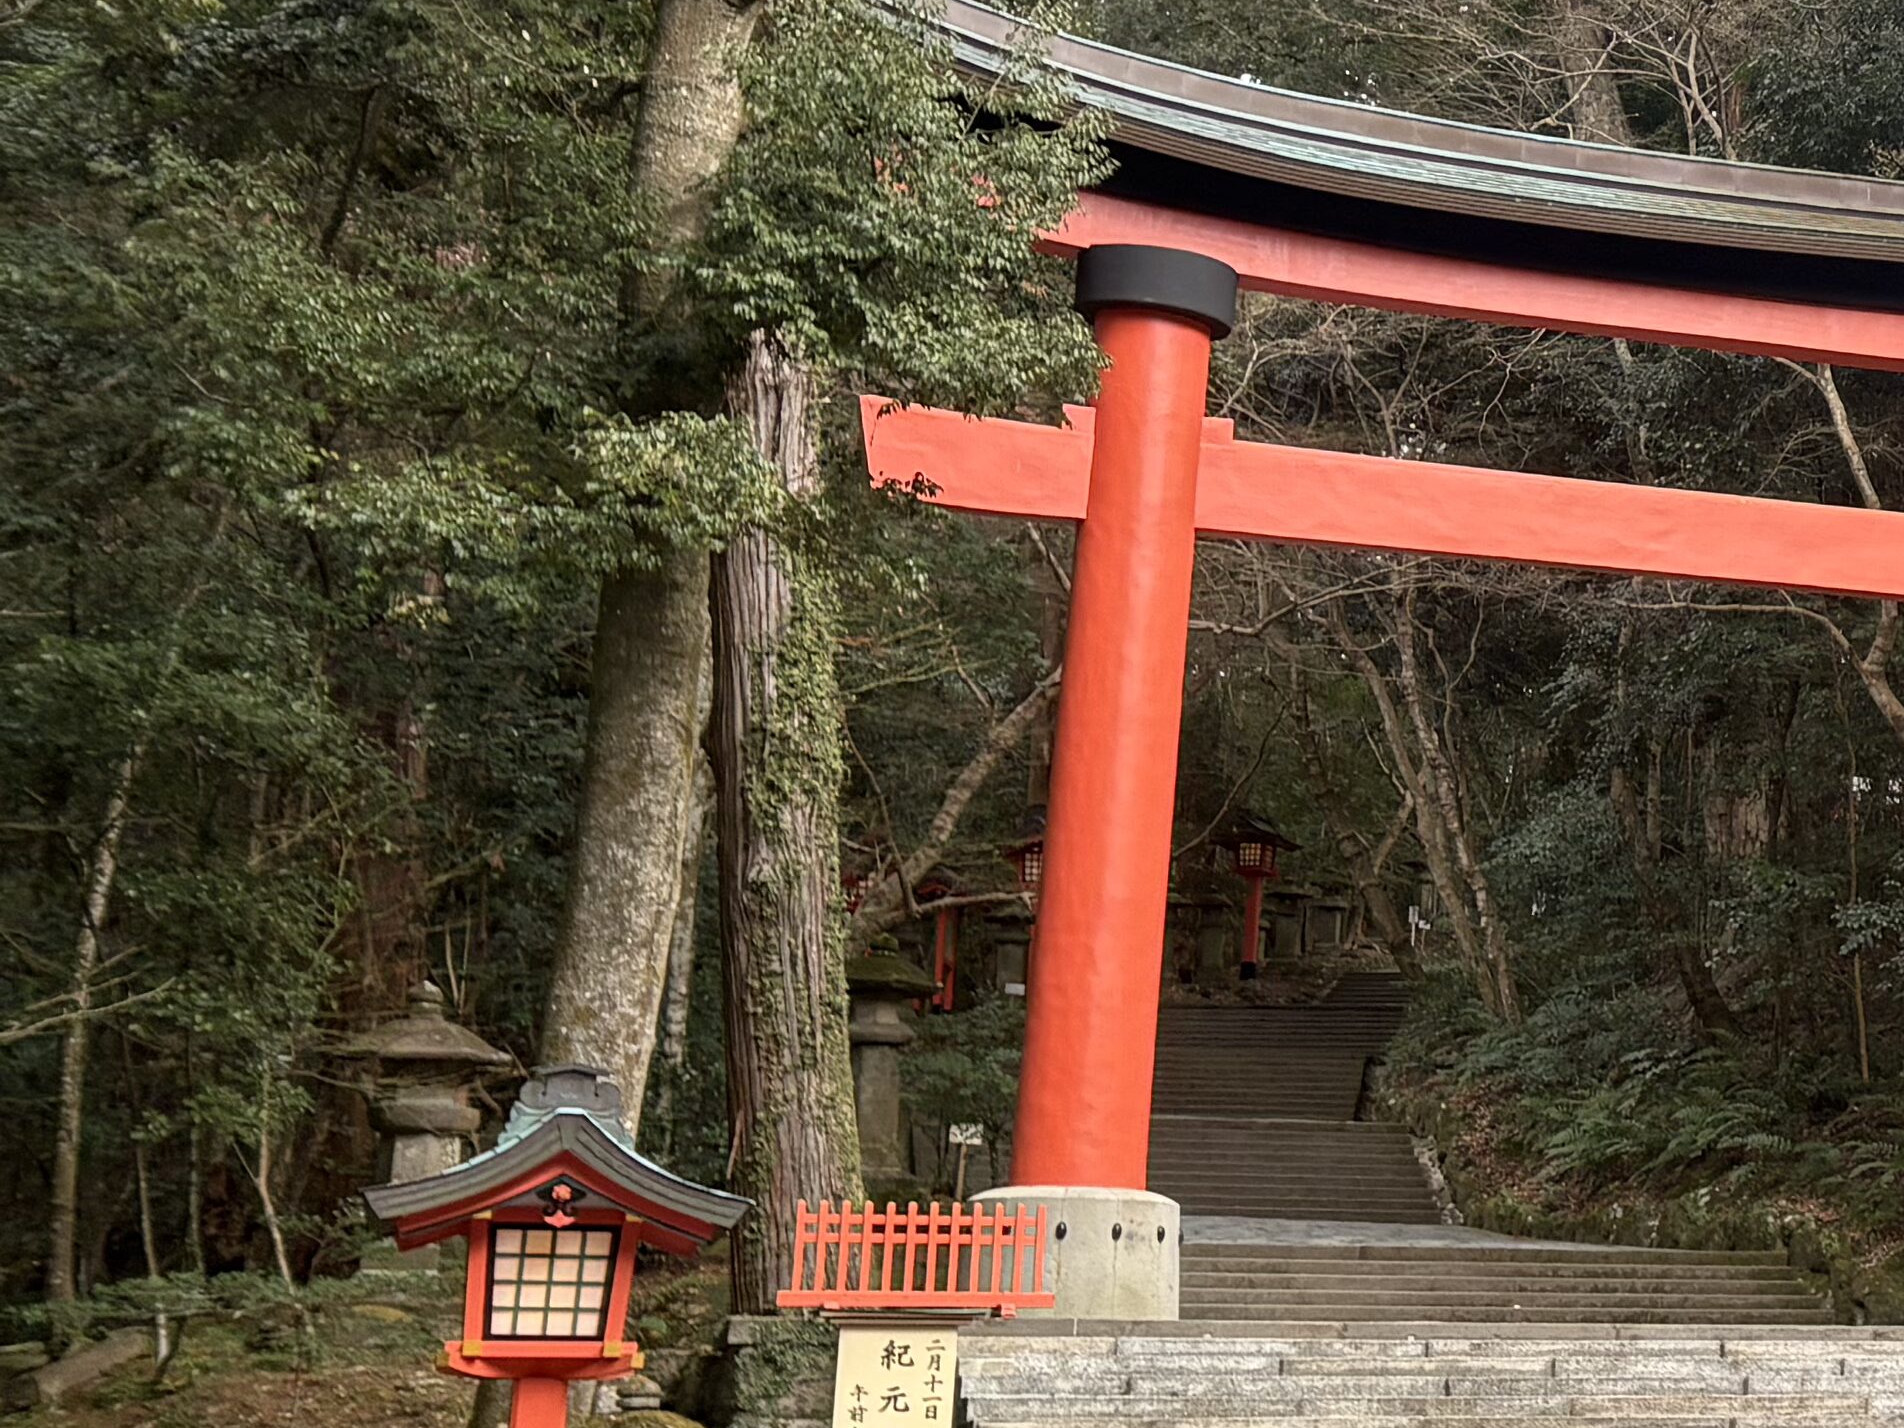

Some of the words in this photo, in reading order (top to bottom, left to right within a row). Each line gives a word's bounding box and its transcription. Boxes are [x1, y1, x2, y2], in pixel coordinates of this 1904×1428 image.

[922, 1339, 946, 1420] 二月十一日
